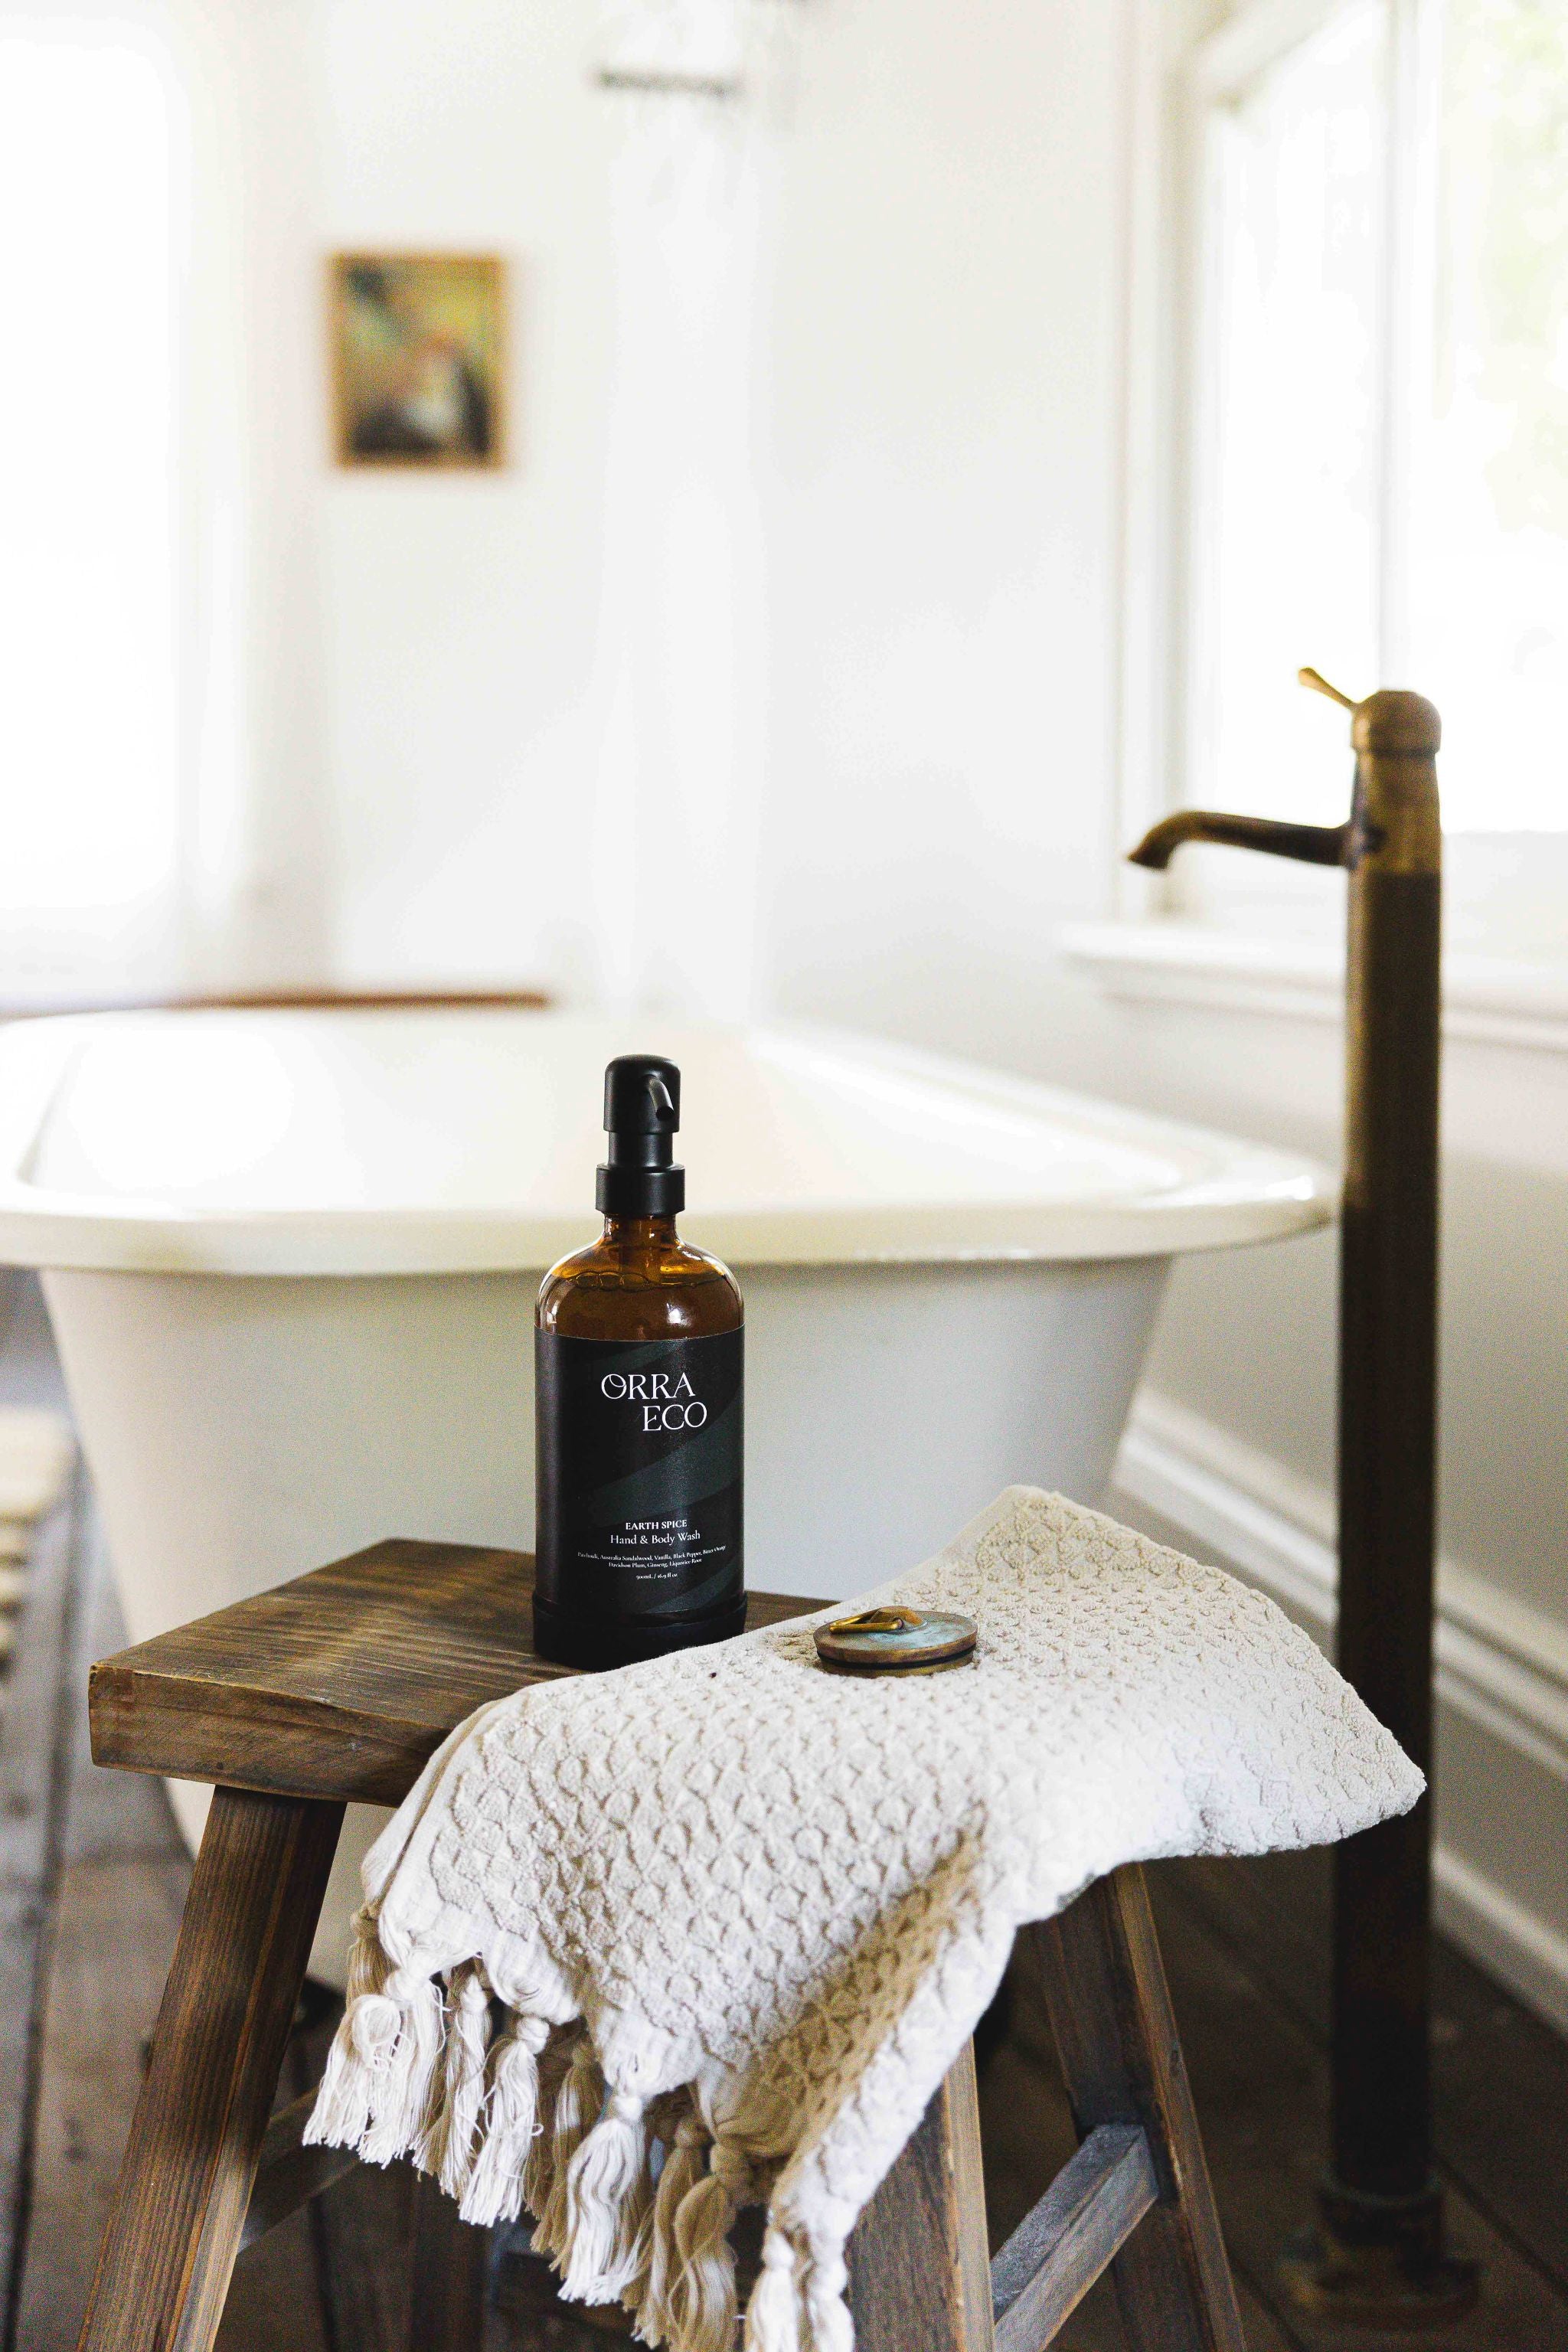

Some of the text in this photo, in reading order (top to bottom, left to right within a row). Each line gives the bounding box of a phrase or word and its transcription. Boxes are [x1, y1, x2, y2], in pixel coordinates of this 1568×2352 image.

[601, 1372, 696, 1400] ORRA
[642, 1401, 707, 1432] ECO
[662, 1520, 688, 1529] SPICE
[610, 1530, 701, 1546] Hand & Body Wash
